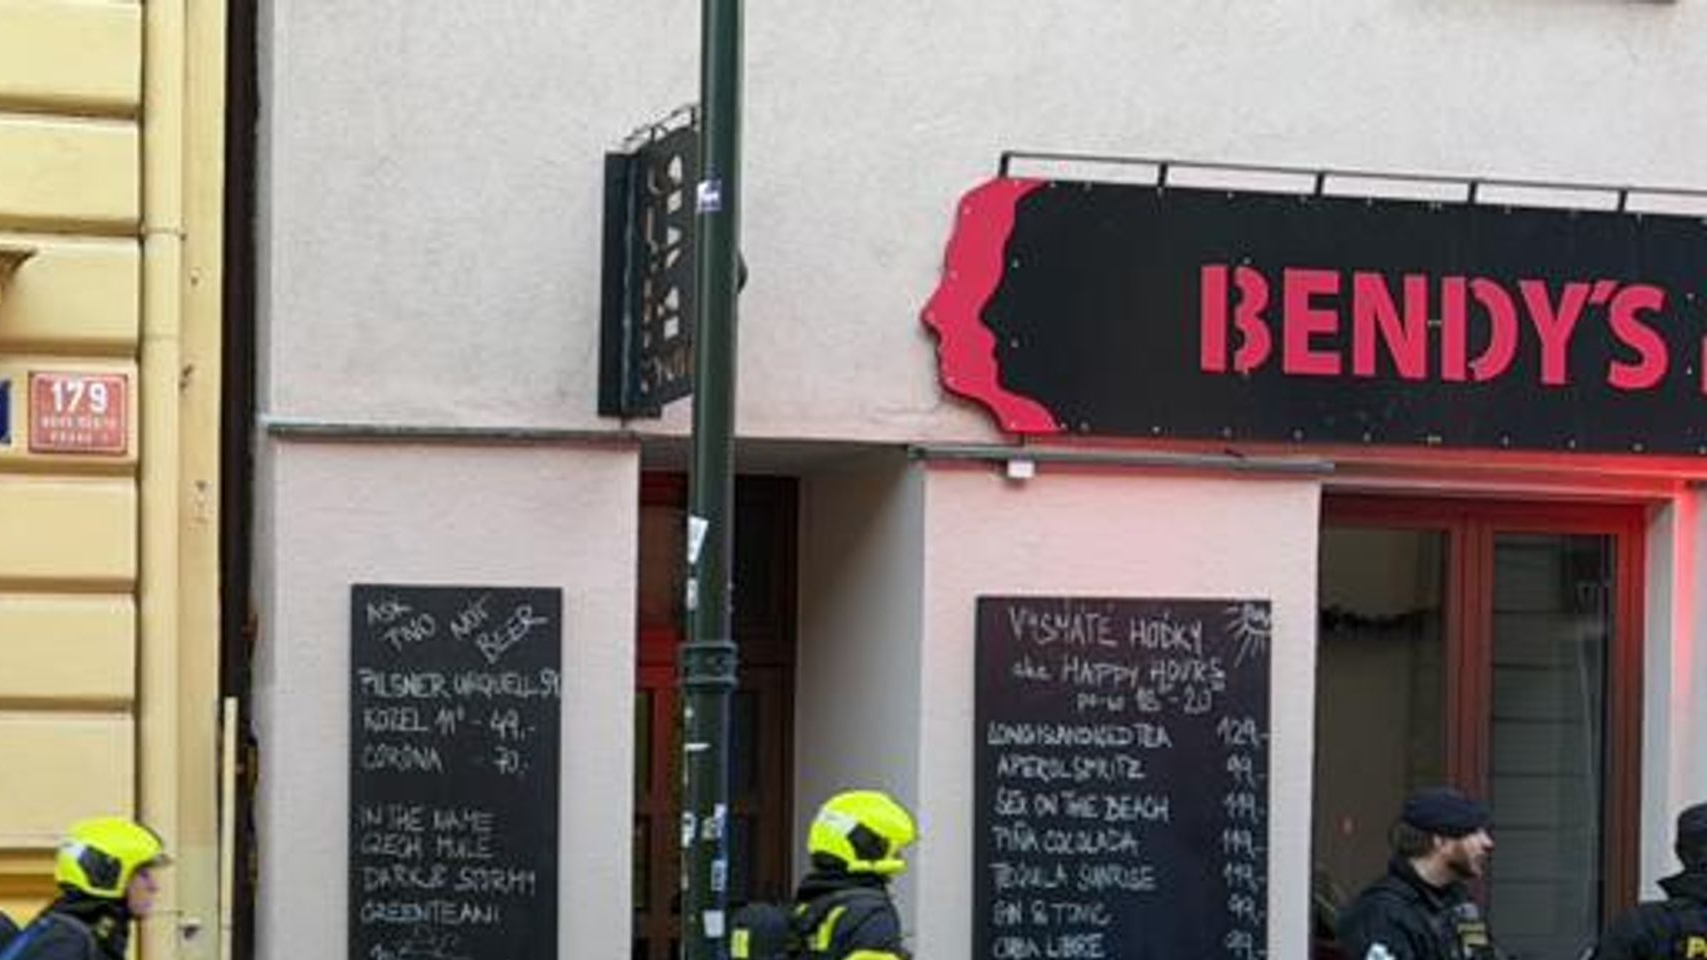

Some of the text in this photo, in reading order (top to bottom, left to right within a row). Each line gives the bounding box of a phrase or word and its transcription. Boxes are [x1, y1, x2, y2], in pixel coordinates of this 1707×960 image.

[51, 380, 108, 415] 179
[1060, 653, 1139, 687] HAPPY
[1150, 656, 1226, 683] HOURS
[363, 706, 428, 733] KOZEL
